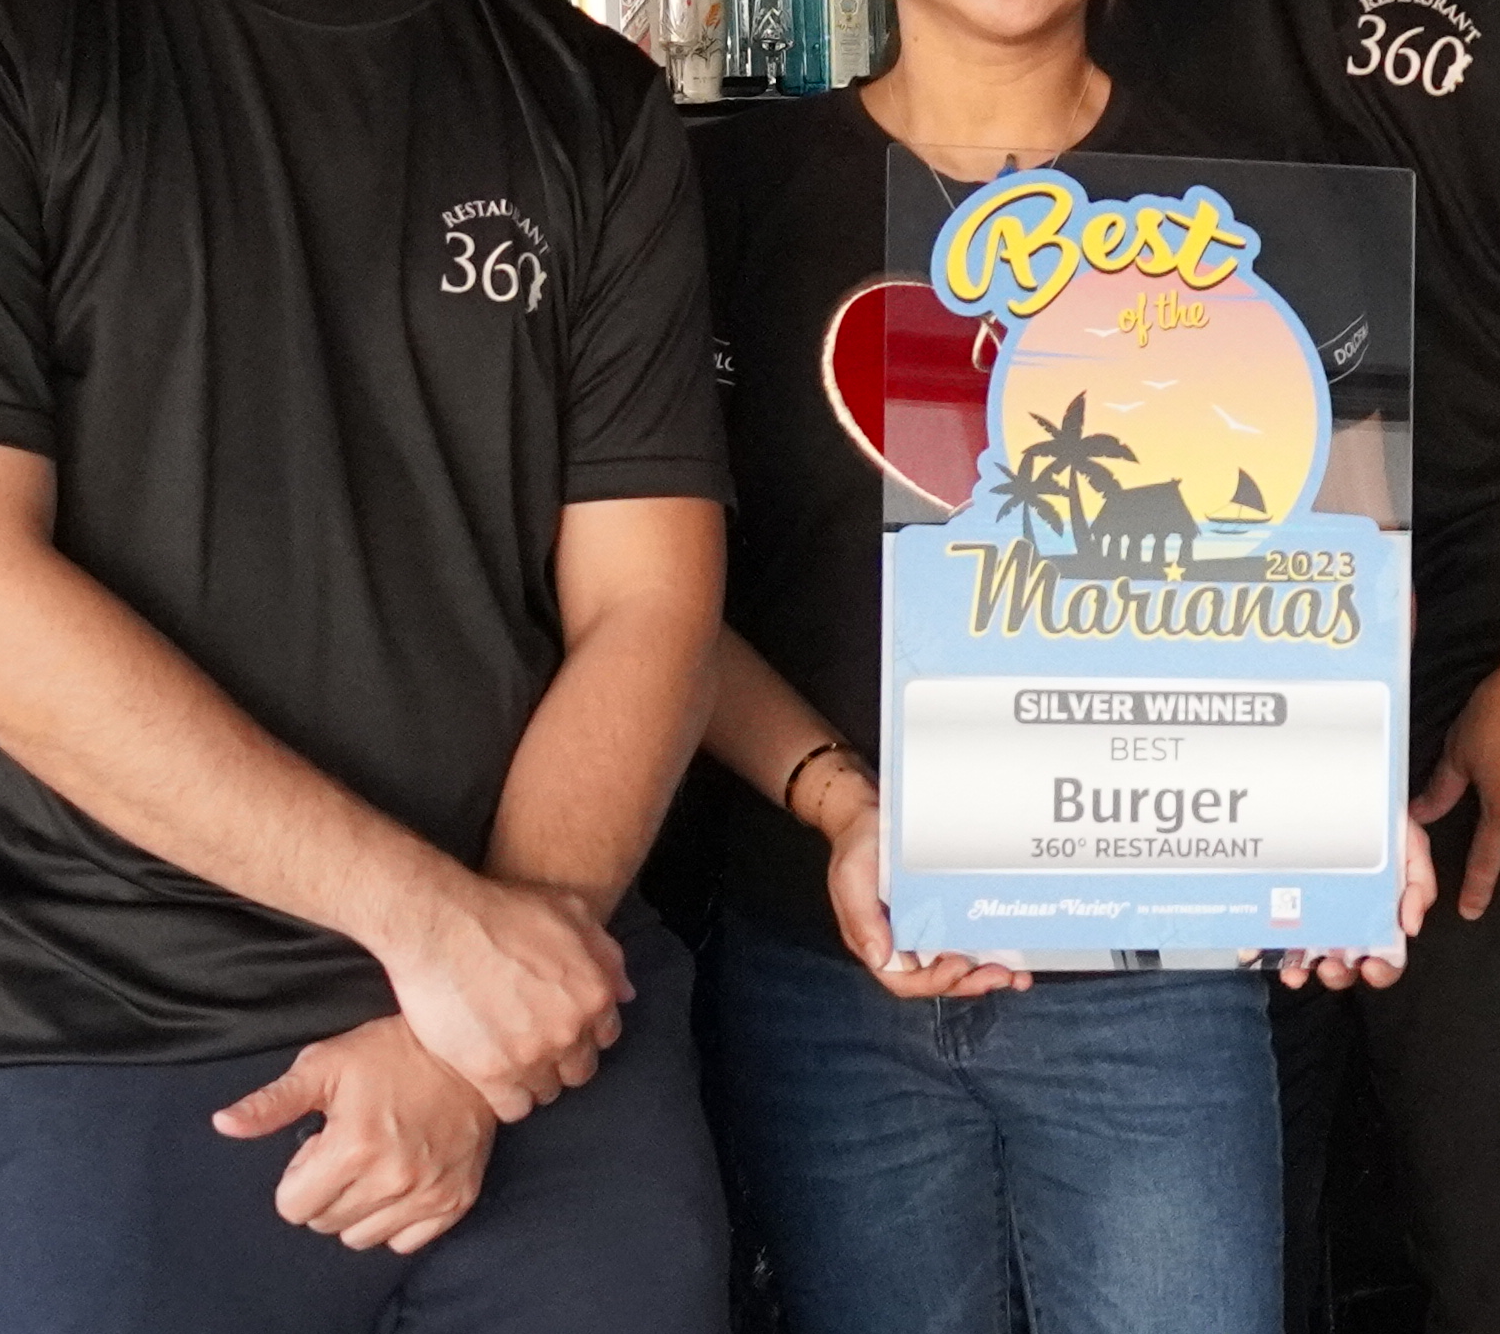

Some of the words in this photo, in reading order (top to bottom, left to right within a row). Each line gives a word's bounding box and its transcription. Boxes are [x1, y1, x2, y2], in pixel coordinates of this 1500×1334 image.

[1346, 14, 1474, 97] 360
[441, 198, 550, 255] RESTAURANT
[946, 181, 1247, 318] Best
[440, 231, 548, 314] 360
[1118, 294, 1151, 348] of
[1155, 288, 1210, 330] the
[948, 536, 1364, 647] Marianas
[1266, 549, 1357, 582] 2023
[1018, 691, 1134, 722] SILVER
[1143, 694, 1277, 723] WINNER
[1110, 737, 1185, 763] BEST
[1052, 776, 1249, 835] Burger
[1031, 837, 1087, 859] 360°
[1095, 837, 1263, 859] RESTAURANT
[967, 898, 1057, 921] Marianas
[1058, 897, 1131, 919] Variety
